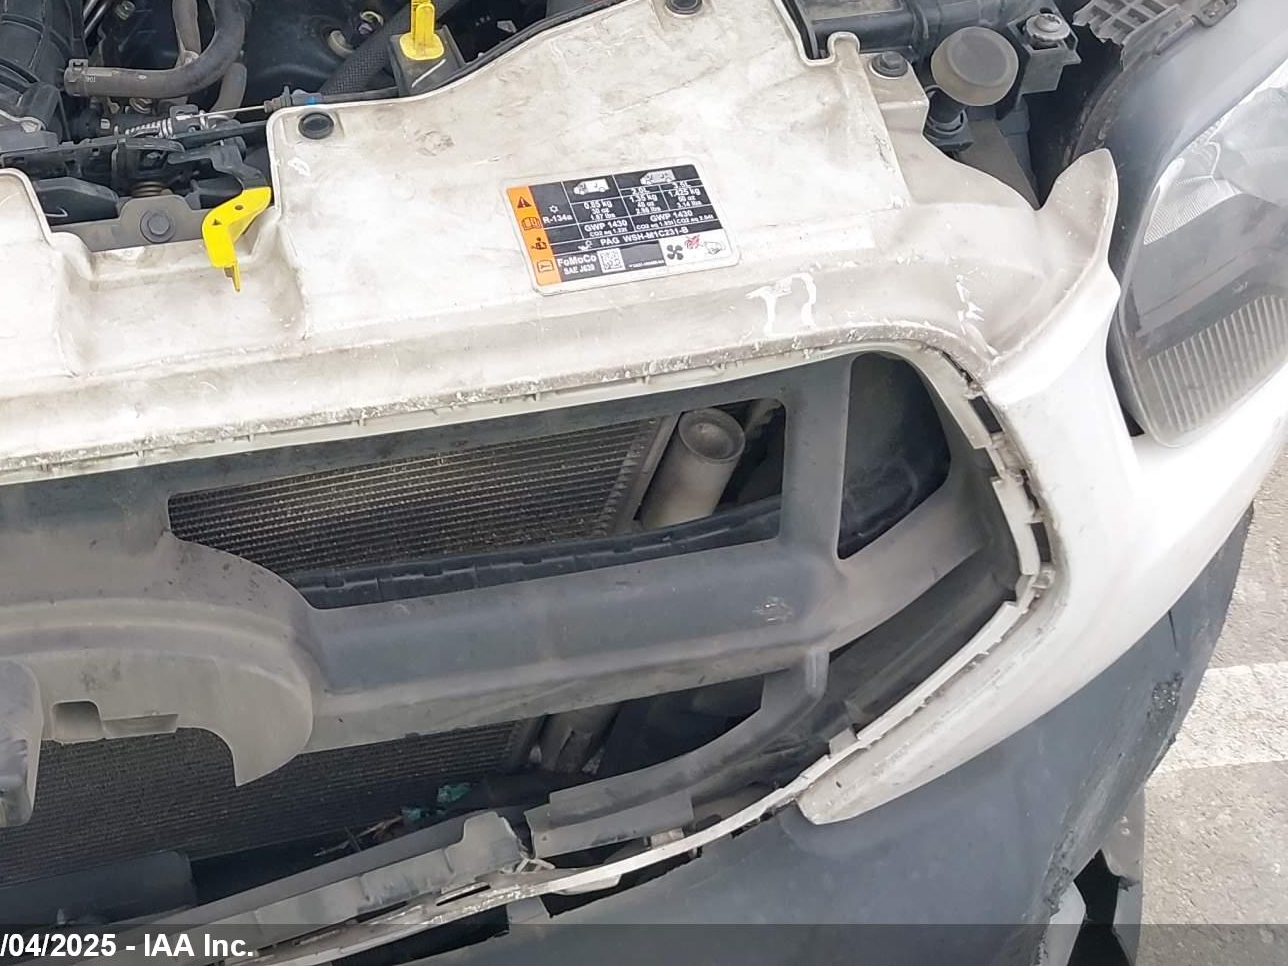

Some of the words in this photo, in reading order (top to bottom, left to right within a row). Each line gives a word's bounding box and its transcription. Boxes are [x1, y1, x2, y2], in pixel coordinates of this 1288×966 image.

[631, 187, 650, 195] 2.0L
[689, 187, 701, 196] kg
[646, 193, 658, 202] kg
[601, 199, 613, 208] kg
[542, 213, 574, 224] R-134a
[650, 213, 671, 222] GWP
[672, 210, 693, 219] 1430
[584, 222, 606, 232] GWP
[606, 219, 628, 229] 1430
[599, 236, 620, 246] PAG
[622, 226, 689, 243] WSH-M1C231-B
[556, 254, 597, 267] FoMoCo
[563, 266, 579, 275] SAE
